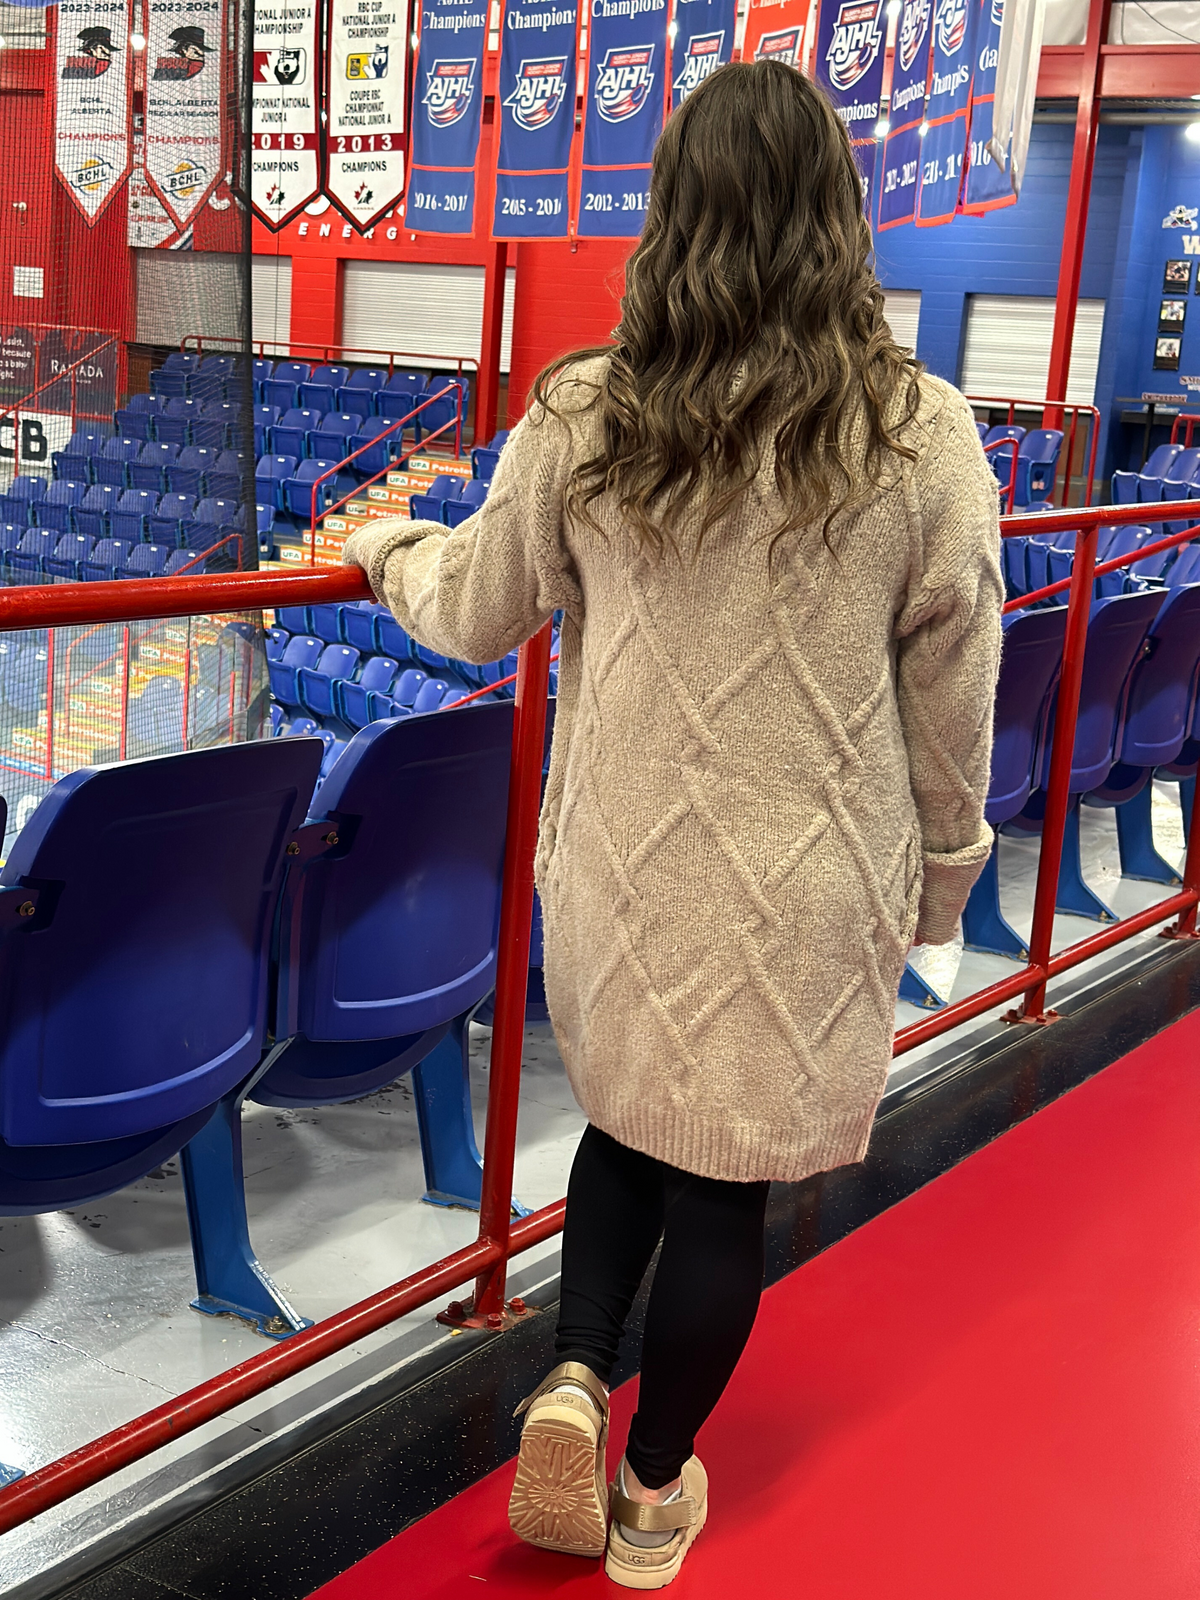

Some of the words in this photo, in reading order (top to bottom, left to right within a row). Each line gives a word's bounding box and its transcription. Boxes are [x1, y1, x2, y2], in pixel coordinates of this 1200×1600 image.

[61, 2, 124, 12] 2023-2024
[152, 2, 219, 12] 2023-2024
[279, 9, 305, 20] JUNIOR
[307, 8, 311, 18] A
[342, 15, 369, 26] NATIONAL
[348, 27, 389, 38] CHAMPIONSHIP
[832, 21, 877, 62] AJHL
[600, 66, 648, 98] AJHL
[427, 76, 471, 105] AJHL
[516, 76, 561, 106] AJHL
[282, 97, 310, 108] NATIONAL
[338, 115, 366, 126] NATIONAL
[58, 132, 126, 141] CHAMPIONS
[148, 136, 219, 145] CHAMPIONS
[337, 134, 393, 153] 2013
[253, 161, 299, 172] CHAMPIONS
[342, 161, 387, 173] CHAMPIONS
[77, 169, 107, 183] BCHL
[170, 172, 200, 188] BCHL
[585, 193, 612, 211] 2012
[298, 222, 416, 241] ENERG
[556, 1395, 574, 1404] UGG
[628, 1554, 645, 1564] UGG
